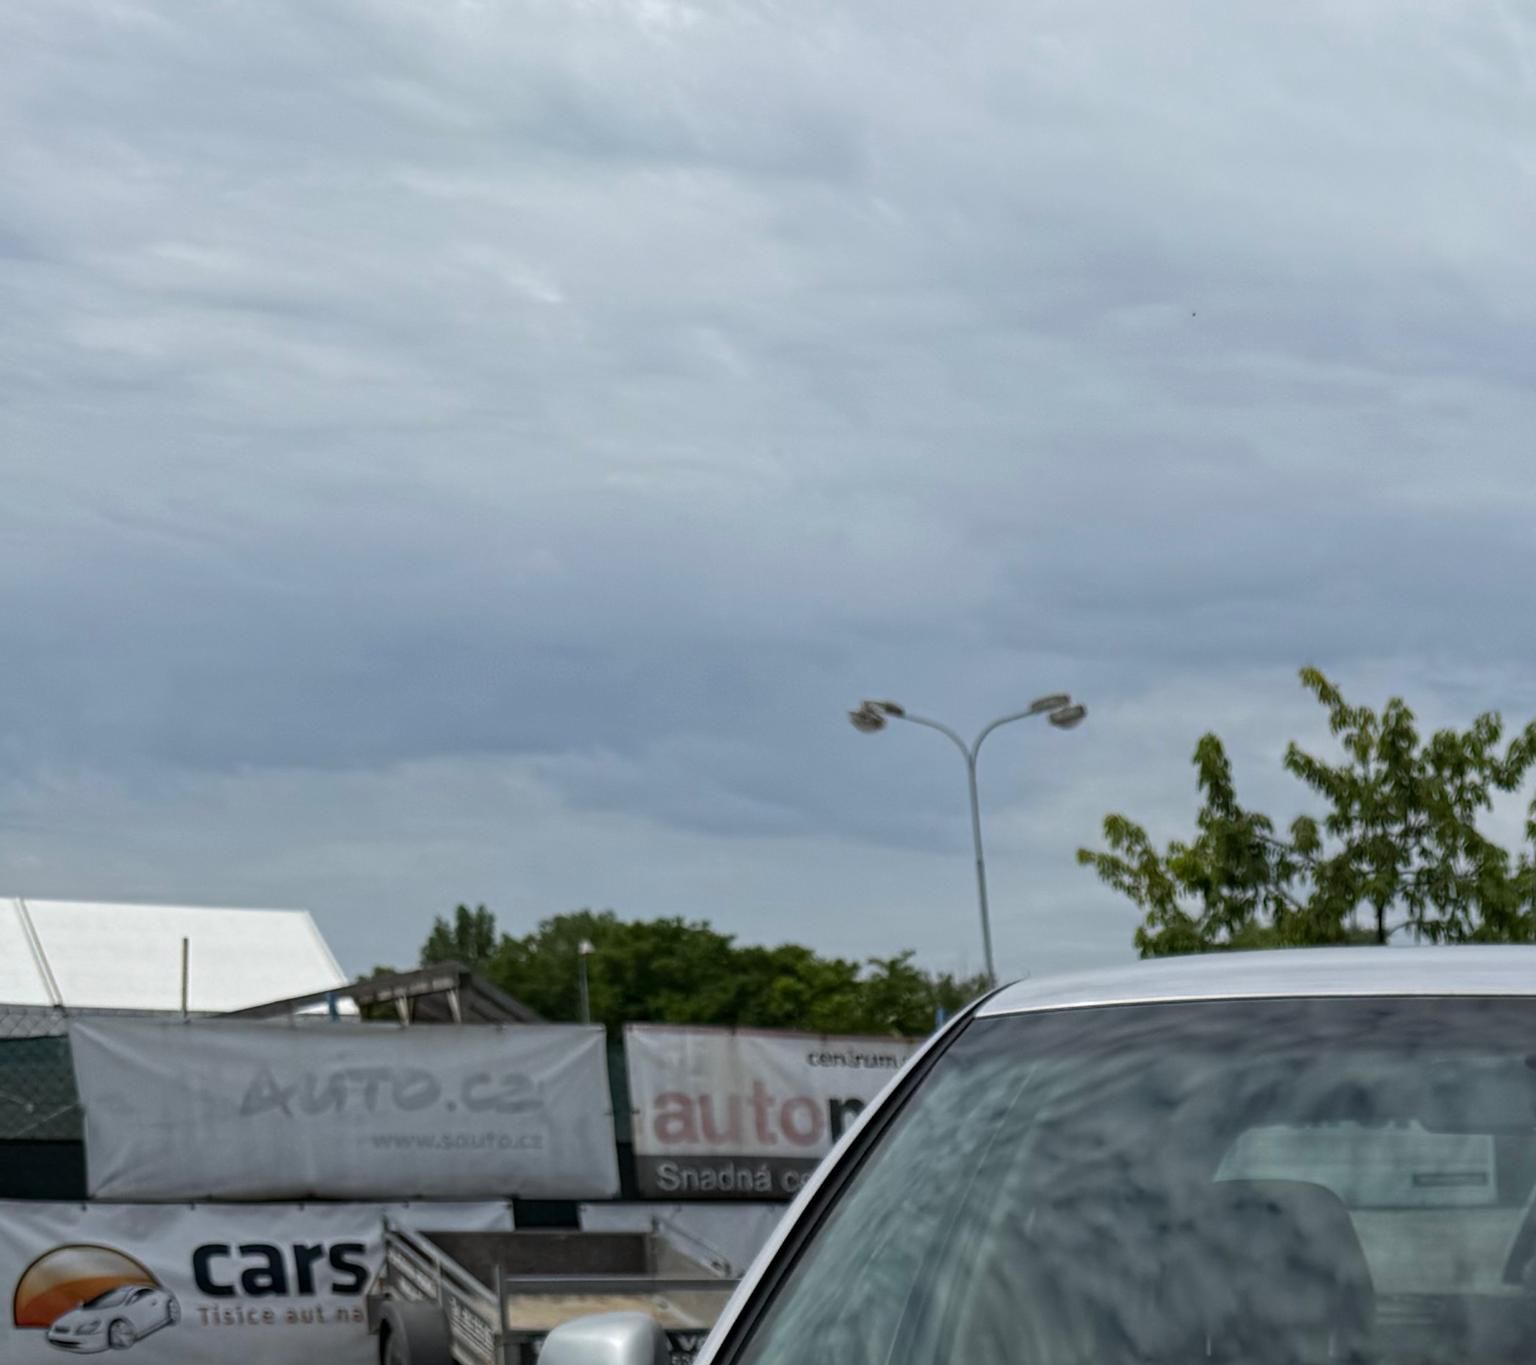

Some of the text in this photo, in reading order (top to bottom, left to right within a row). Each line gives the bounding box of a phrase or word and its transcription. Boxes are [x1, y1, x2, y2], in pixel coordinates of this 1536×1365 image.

[656, 1161, 772, 1191] Snadná
[192, 1242, 369, 1297] cars
[284, 1304, 326, 1325] aut
